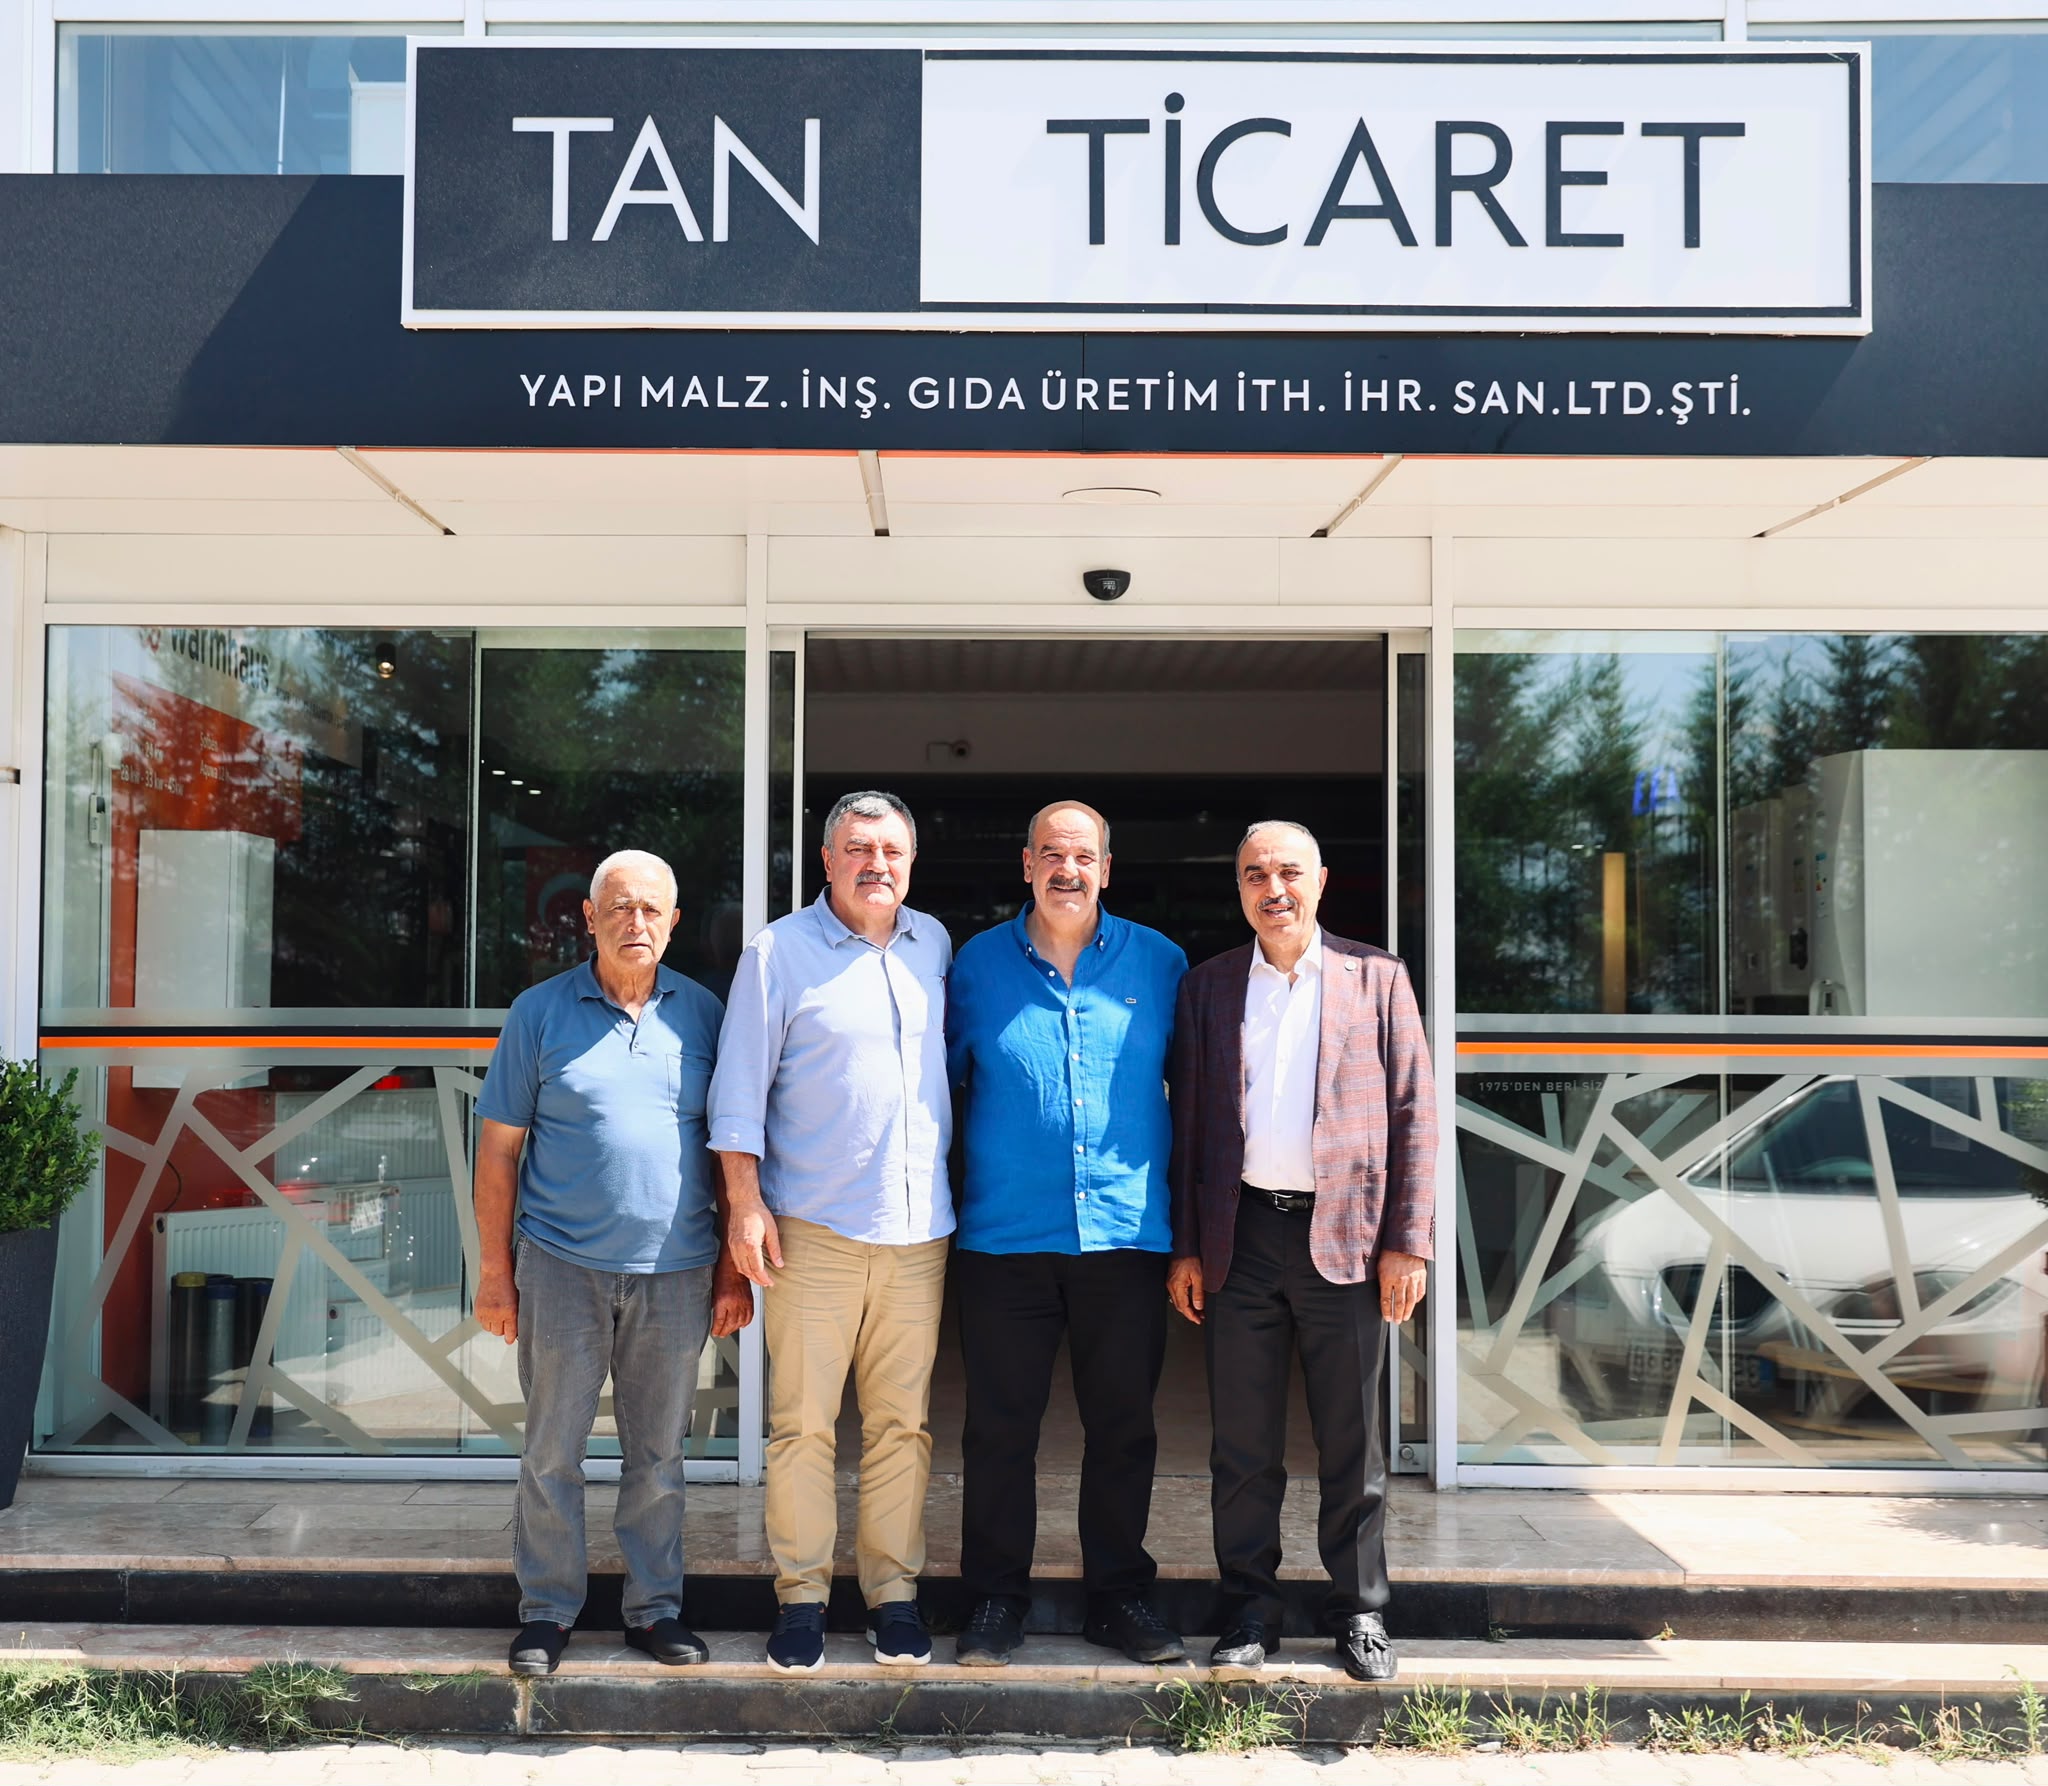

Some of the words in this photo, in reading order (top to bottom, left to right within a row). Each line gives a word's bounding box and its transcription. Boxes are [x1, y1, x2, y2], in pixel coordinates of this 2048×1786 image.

[512, 114, 820, 246] TAN
[1046, 92, 1746, 248] TİCARET
[519, 374, 622, 408] YAPI
[908, 376, 1026, 411] GIDA
[1042, 369, 1217, 411] ÜRETİM
[1237, 371, 1326, 412] İTH.
[1344, 370, 1436, 412] İHR.
[1479, 1081, 1541, 1092] 1975'DEN
[1546, 1079, 1577, 1092] BERİ
